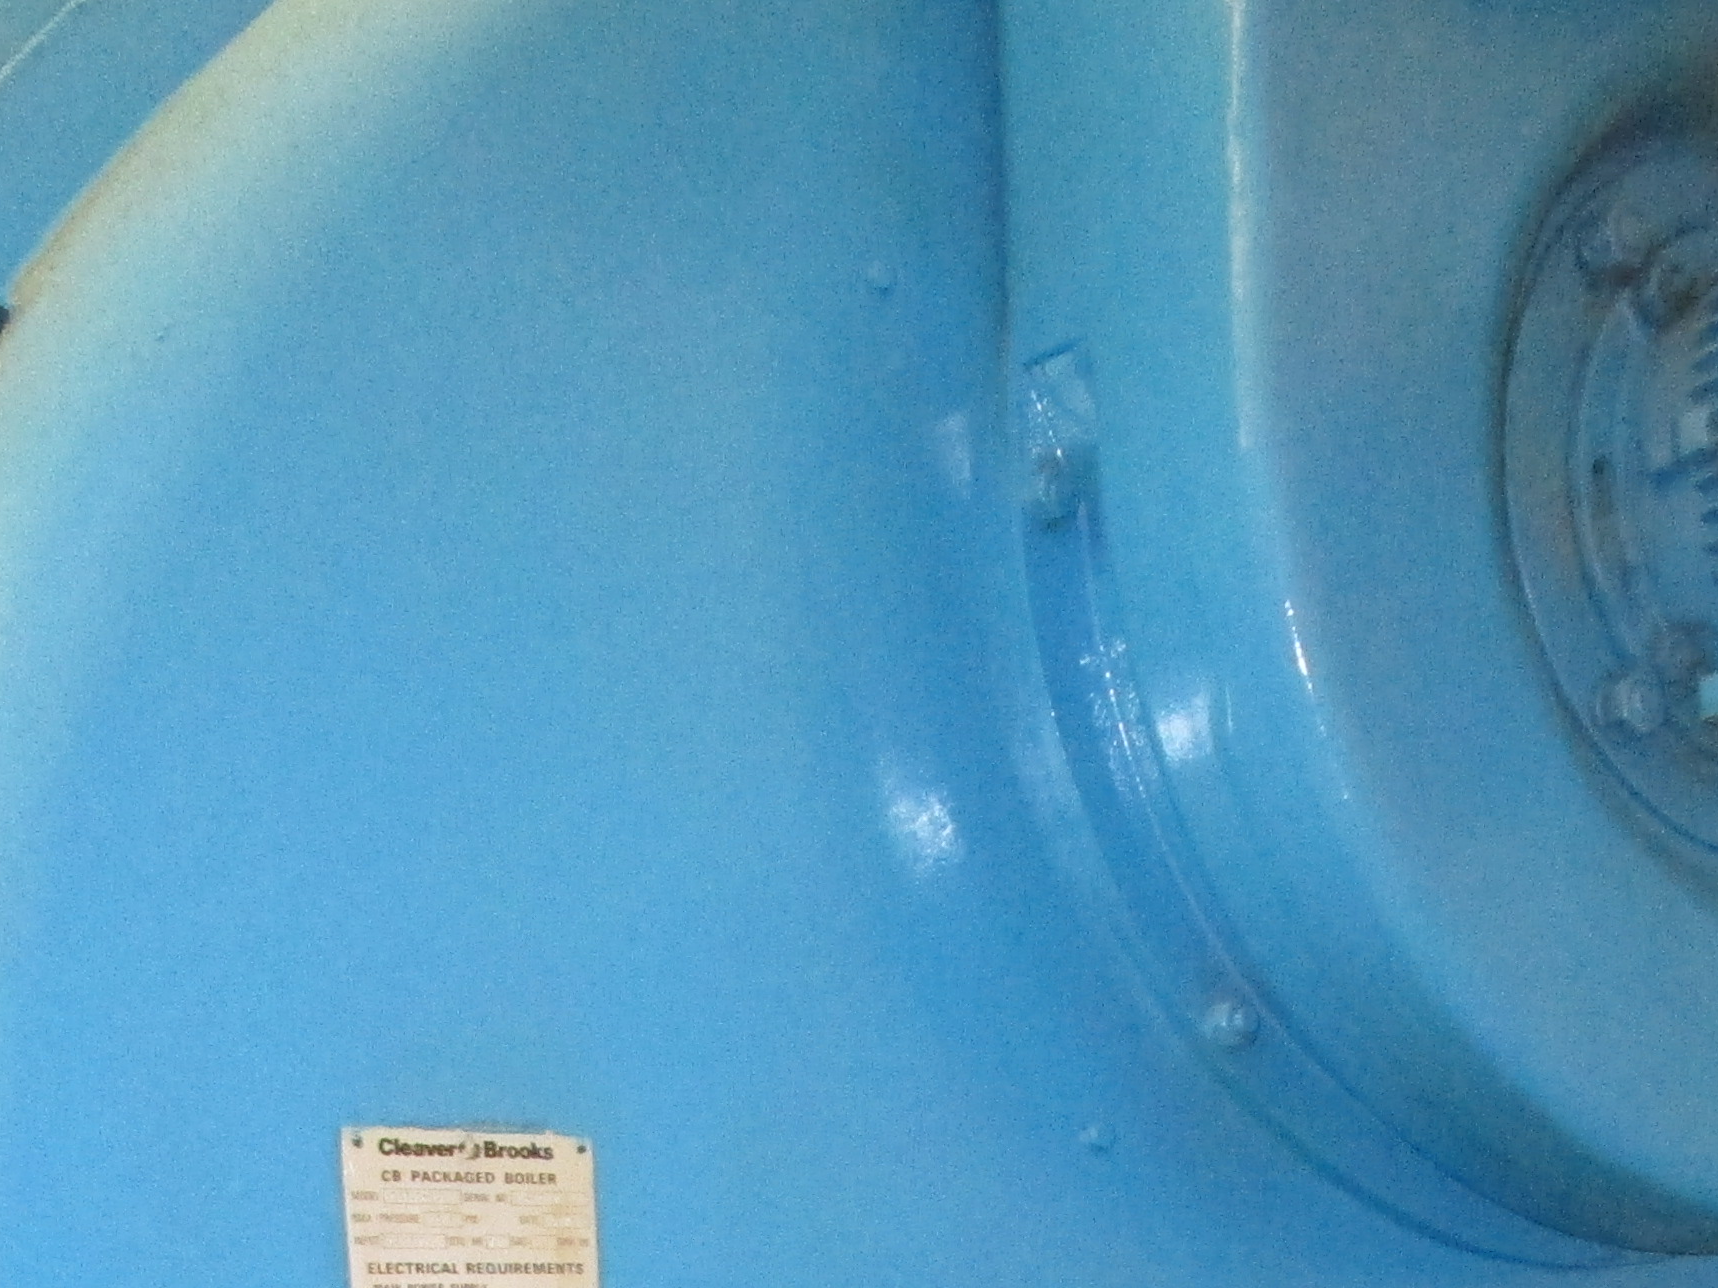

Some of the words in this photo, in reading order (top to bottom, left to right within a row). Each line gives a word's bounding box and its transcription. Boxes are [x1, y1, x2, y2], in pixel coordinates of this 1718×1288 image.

[378, 1137, 459, 1157] Cleaver
[484, 1140, 554, 1160] Brooks
[381, 1170, 401, 1182] CB
[411, 1170, 495, 1184] PACKAGED
[505, 1172, 557, 1185] BOILER
[367, 1262, 460, 1274] ELECTRICAL
[466, 1262, 584, 1275] REQUIREMENTS
